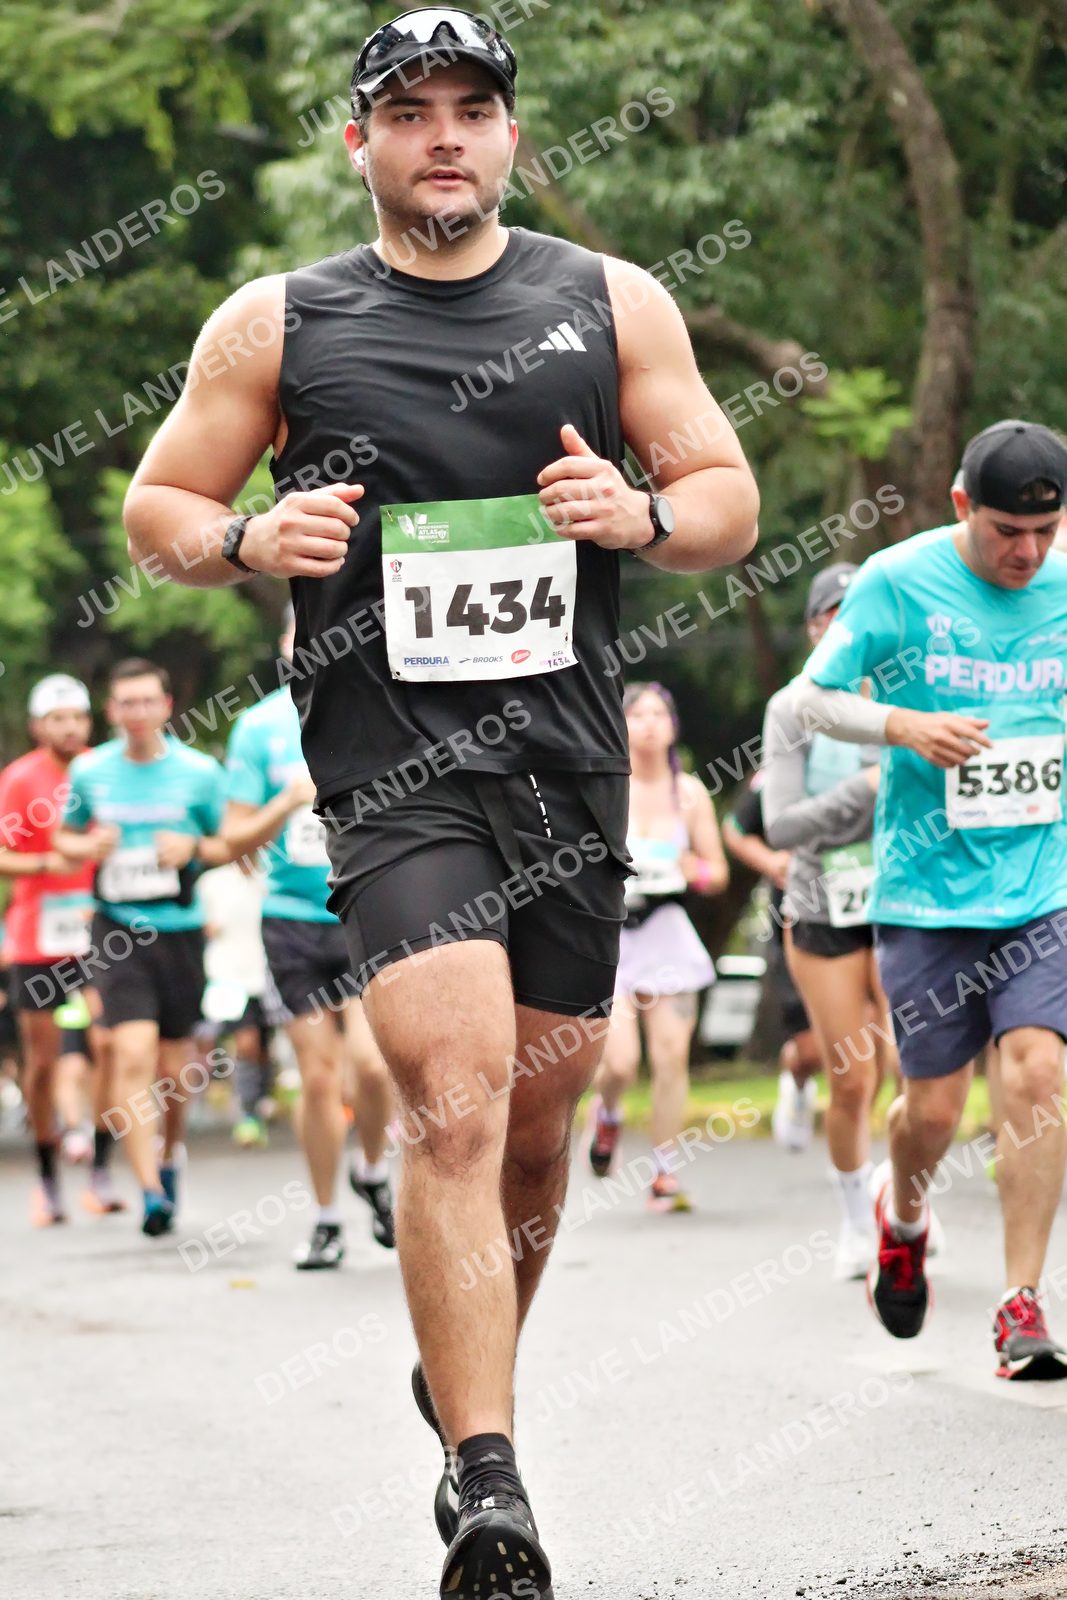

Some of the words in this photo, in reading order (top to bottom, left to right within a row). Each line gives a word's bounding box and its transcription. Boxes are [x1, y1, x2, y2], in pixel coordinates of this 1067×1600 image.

[404, 576, 566, 639] 1434
[404, 656, 450, 666] PERDURA
[472, 656, 503, 664] BROOKS
[548, 657, 571, 669] 1434
[925, 655, 1067, 693] PERDUR
[957, 758, 1061, 798] 5386
